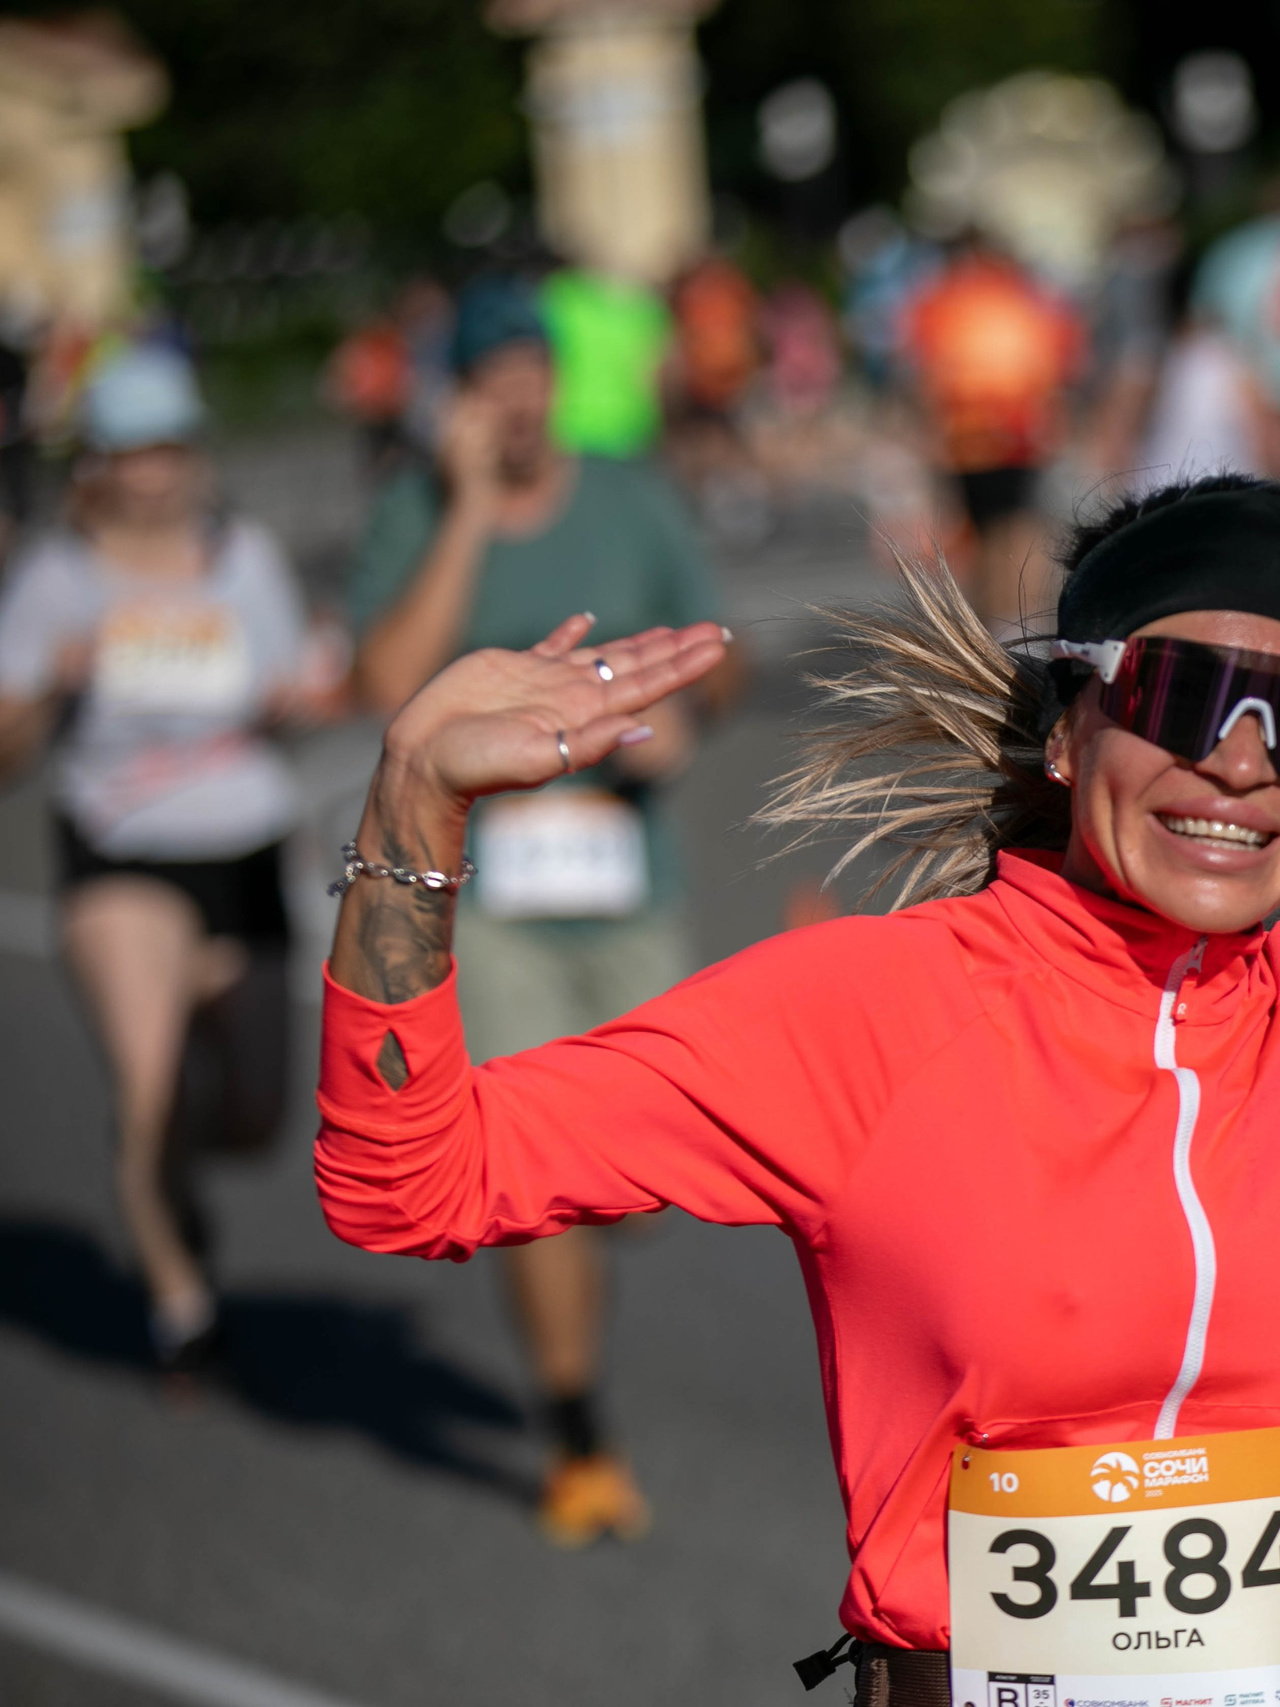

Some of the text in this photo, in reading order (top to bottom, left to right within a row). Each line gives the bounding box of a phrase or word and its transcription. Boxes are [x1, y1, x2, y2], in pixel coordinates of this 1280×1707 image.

[1143, 1456, 1208, 1478] СОЧИ
[989, 1472, 1019, 1493] 10
[1144, 1473, 1209, 1488] МАРАФОН
[1112, 1628, 1205, 1651] ОЛЬГА
[1032, 1689, 1050, 1700] 35
